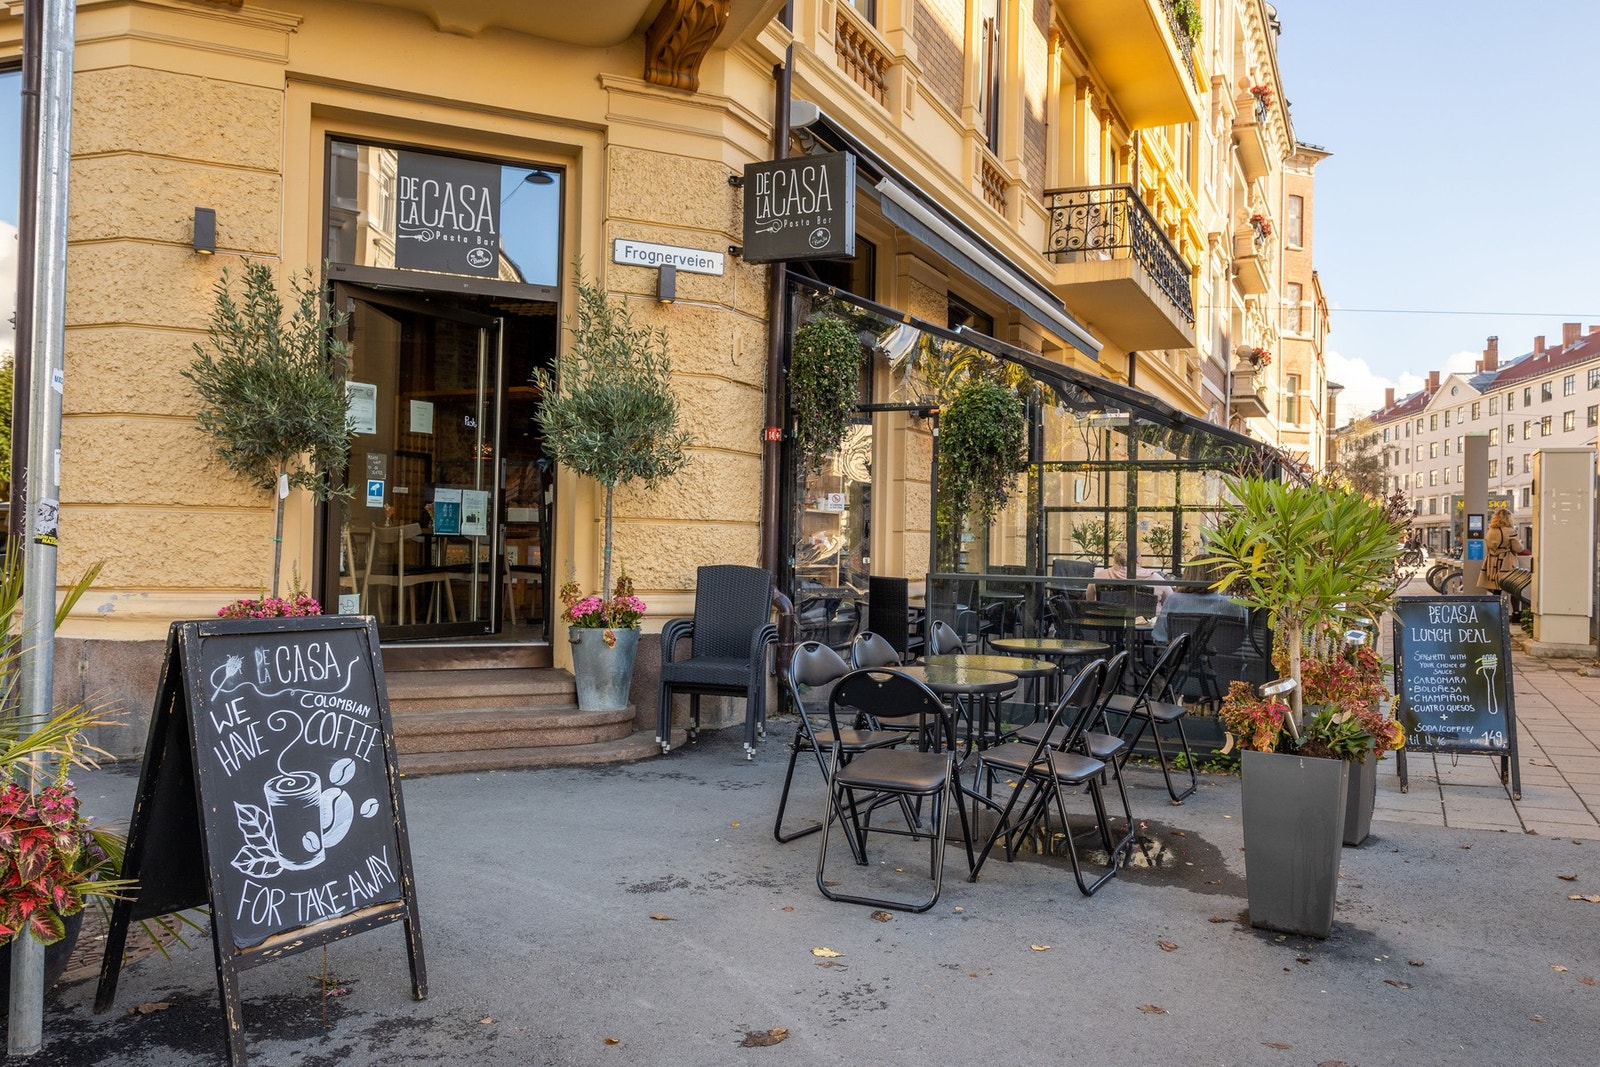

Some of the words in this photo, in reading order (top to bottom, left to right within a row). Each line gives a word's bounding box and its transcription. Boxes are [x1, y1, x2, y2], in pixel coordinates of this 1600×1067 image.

[400, 176, 419, 201] DE
[756, 172, 770, 196] DE
[772, 164, 833, 217] CASA
[400, 200, 419, 225] LA
[421, 180, 496, 235] CASA
[756, 196, 771, 219] LA
[784, 218, 810, 228] Pasta
[816, 216, 832, 225] Bar
[436, 230, 468, 243] Pasta
[476, 236, 494, 246] Bar
[625, 245, 715, 269] Frognerveien
[1428, 605, 1441, 616] DE
[1430, 615, 1441, 624] LA
[1441, 604, 1479, 624] CASA
[1412, 628, 1452, 643] LUNCH
[1458, 628, 1492, 643] DEAL
[254, 647, 270, 668] DE
[276, 642, 341, 684] CASA
[256, 667, 272, 684] LA
[1414, 676, 1467, 684] CARBONARA
[210, 696, 250, 734] WE
[300, 693, 371, 718] COLOMBIAN
[1414, 704, 1445, 712] CUATRO
[1446, 704, 1475, 713] QUESOS
[213, 720, 270, 777] HAVE
[304, 710, 381, 763] COFFEE
[236, 880, 286, 926] FOR
[290, 845, 396, 922] TAKE-AWAY
